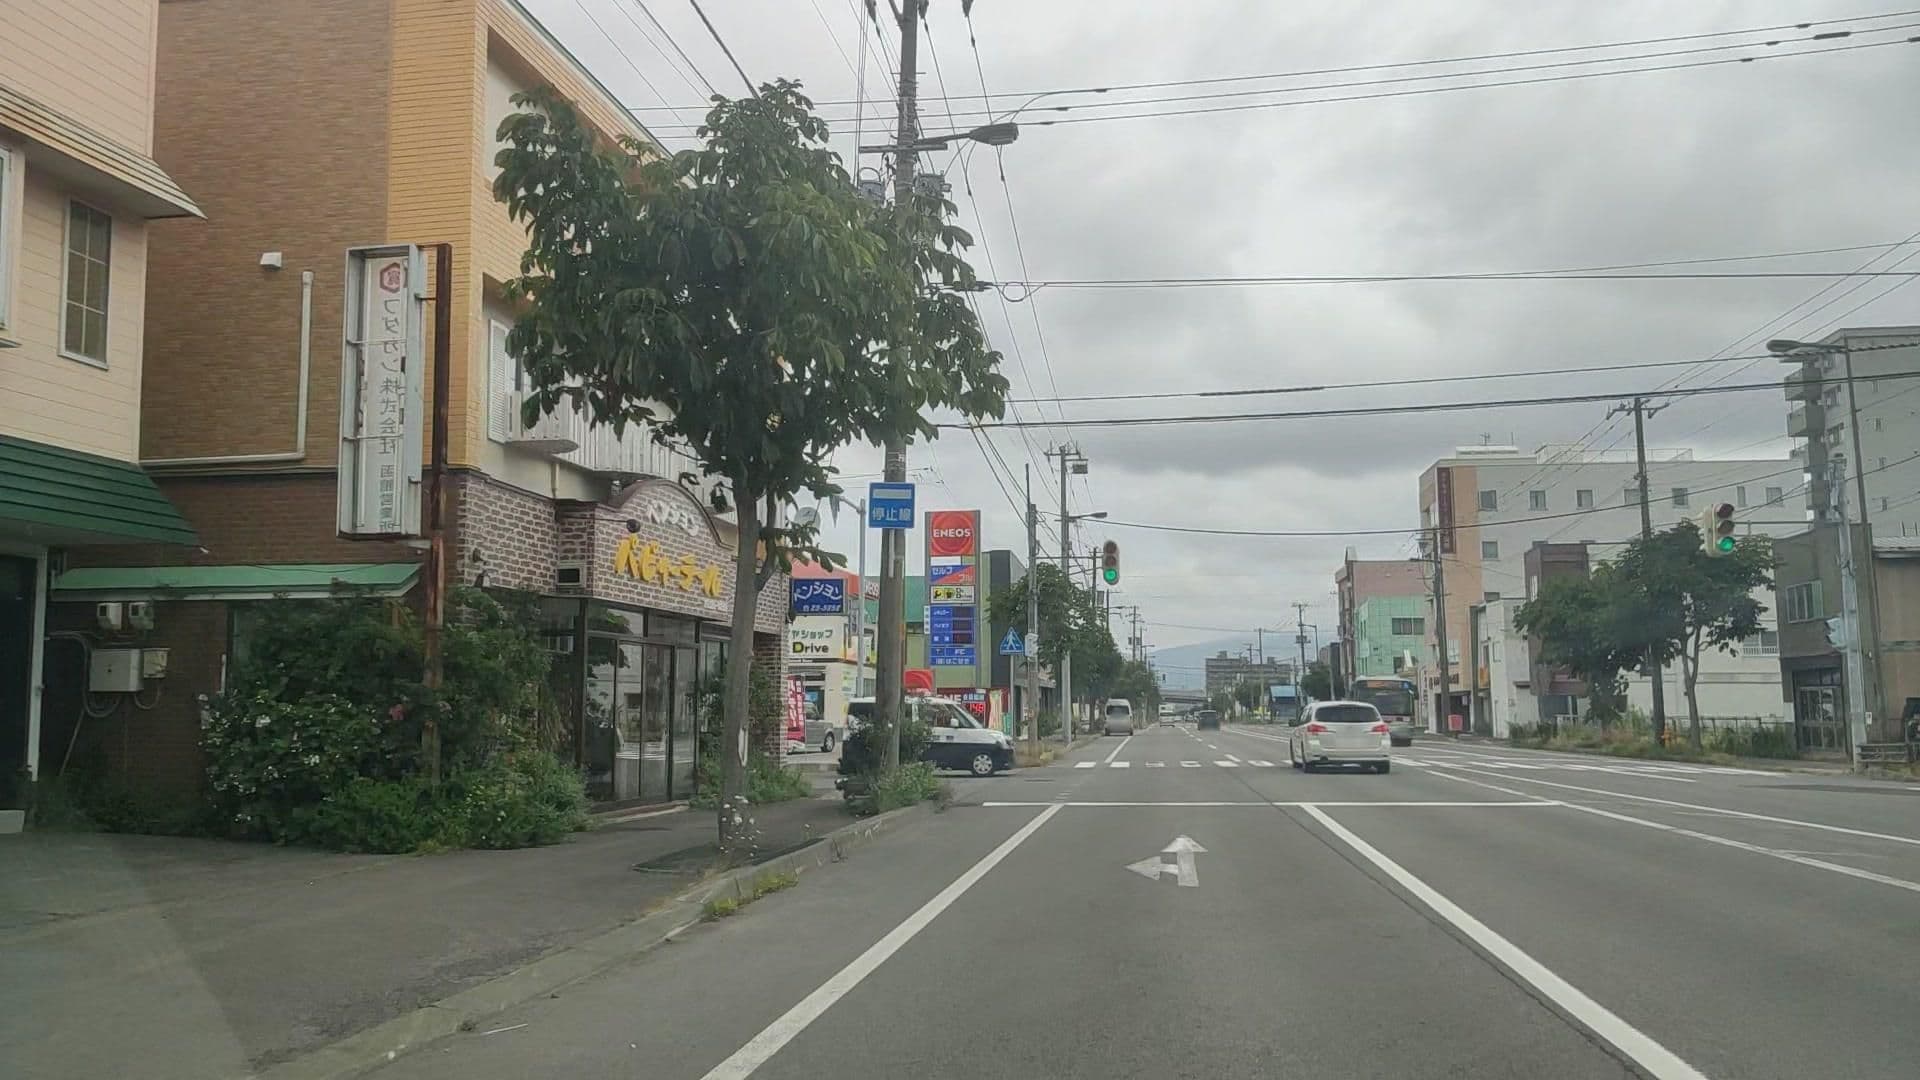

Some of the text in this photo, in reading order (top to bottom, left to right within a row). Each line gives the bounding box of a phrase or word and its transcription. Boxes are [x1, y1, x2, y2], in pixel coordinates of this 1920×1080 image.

[872, 506, 911, 521] 停止線
[932, 528, 972, 538] ENEOS
[792, 641, 829, 654] Drive
